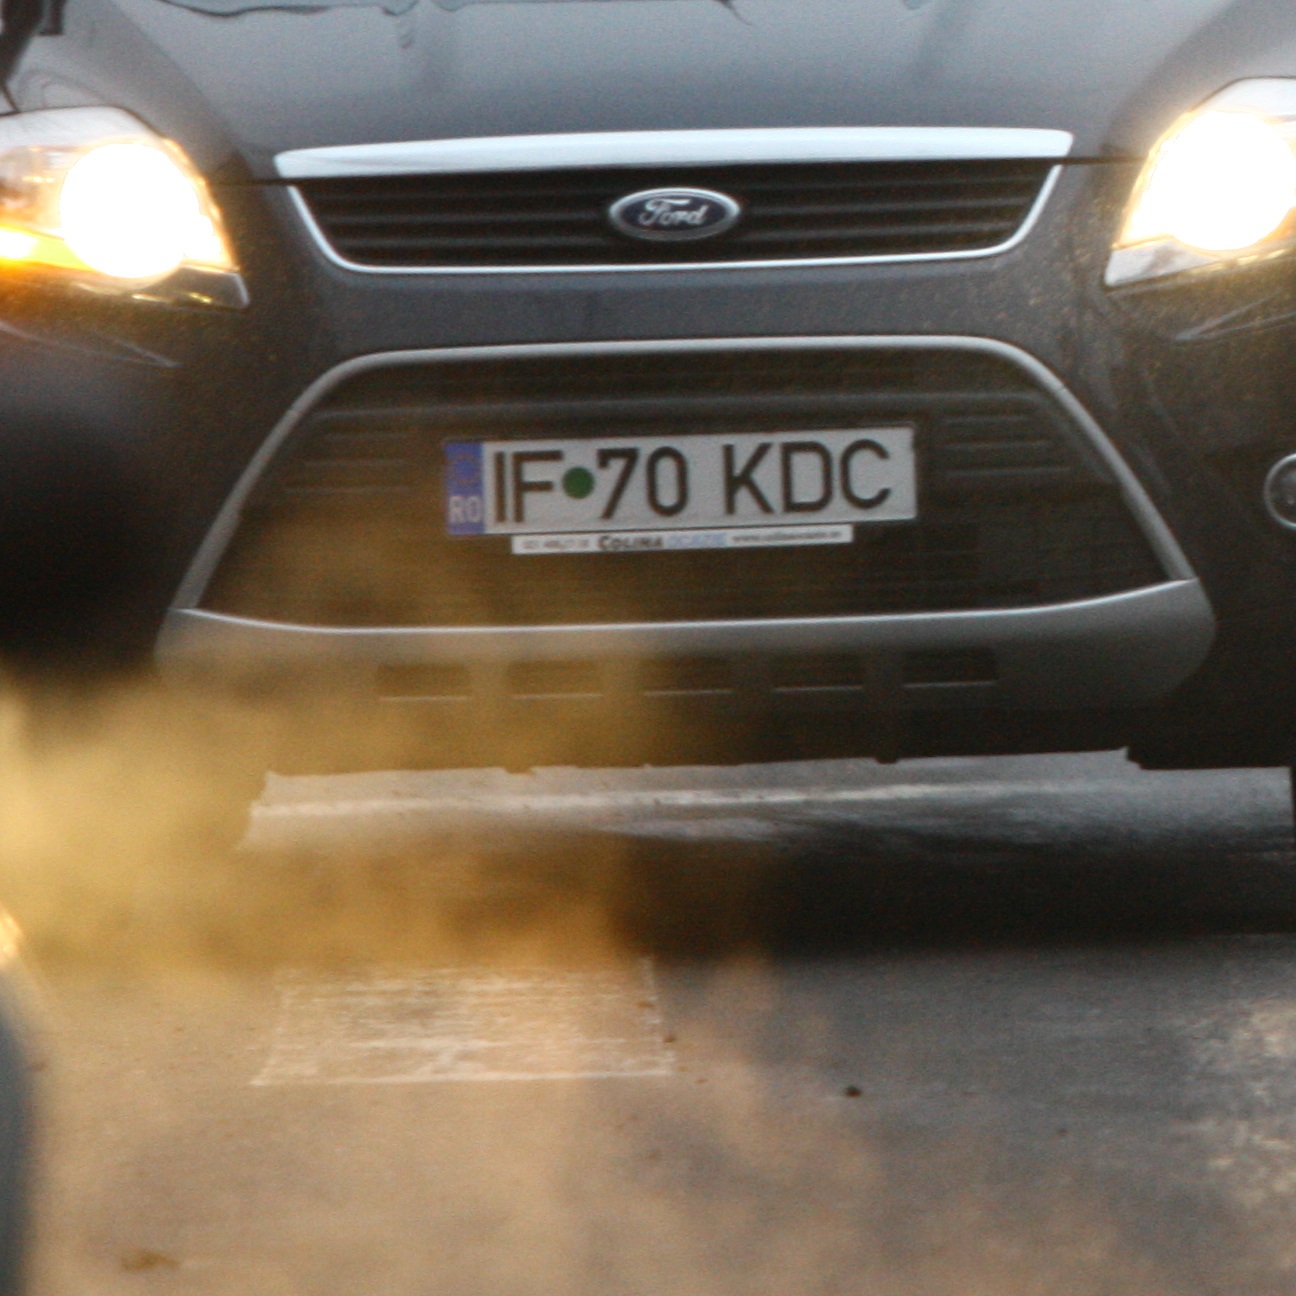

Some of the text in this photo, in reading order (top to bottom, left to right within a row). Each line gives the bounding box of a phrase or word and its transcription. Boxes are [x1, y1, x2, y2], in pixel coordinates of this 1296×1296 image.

[639, 197, 708, 227] Ford
[495, 438, 891, 524] IF 70 KDC
[449, 494, 482, 524] RO
